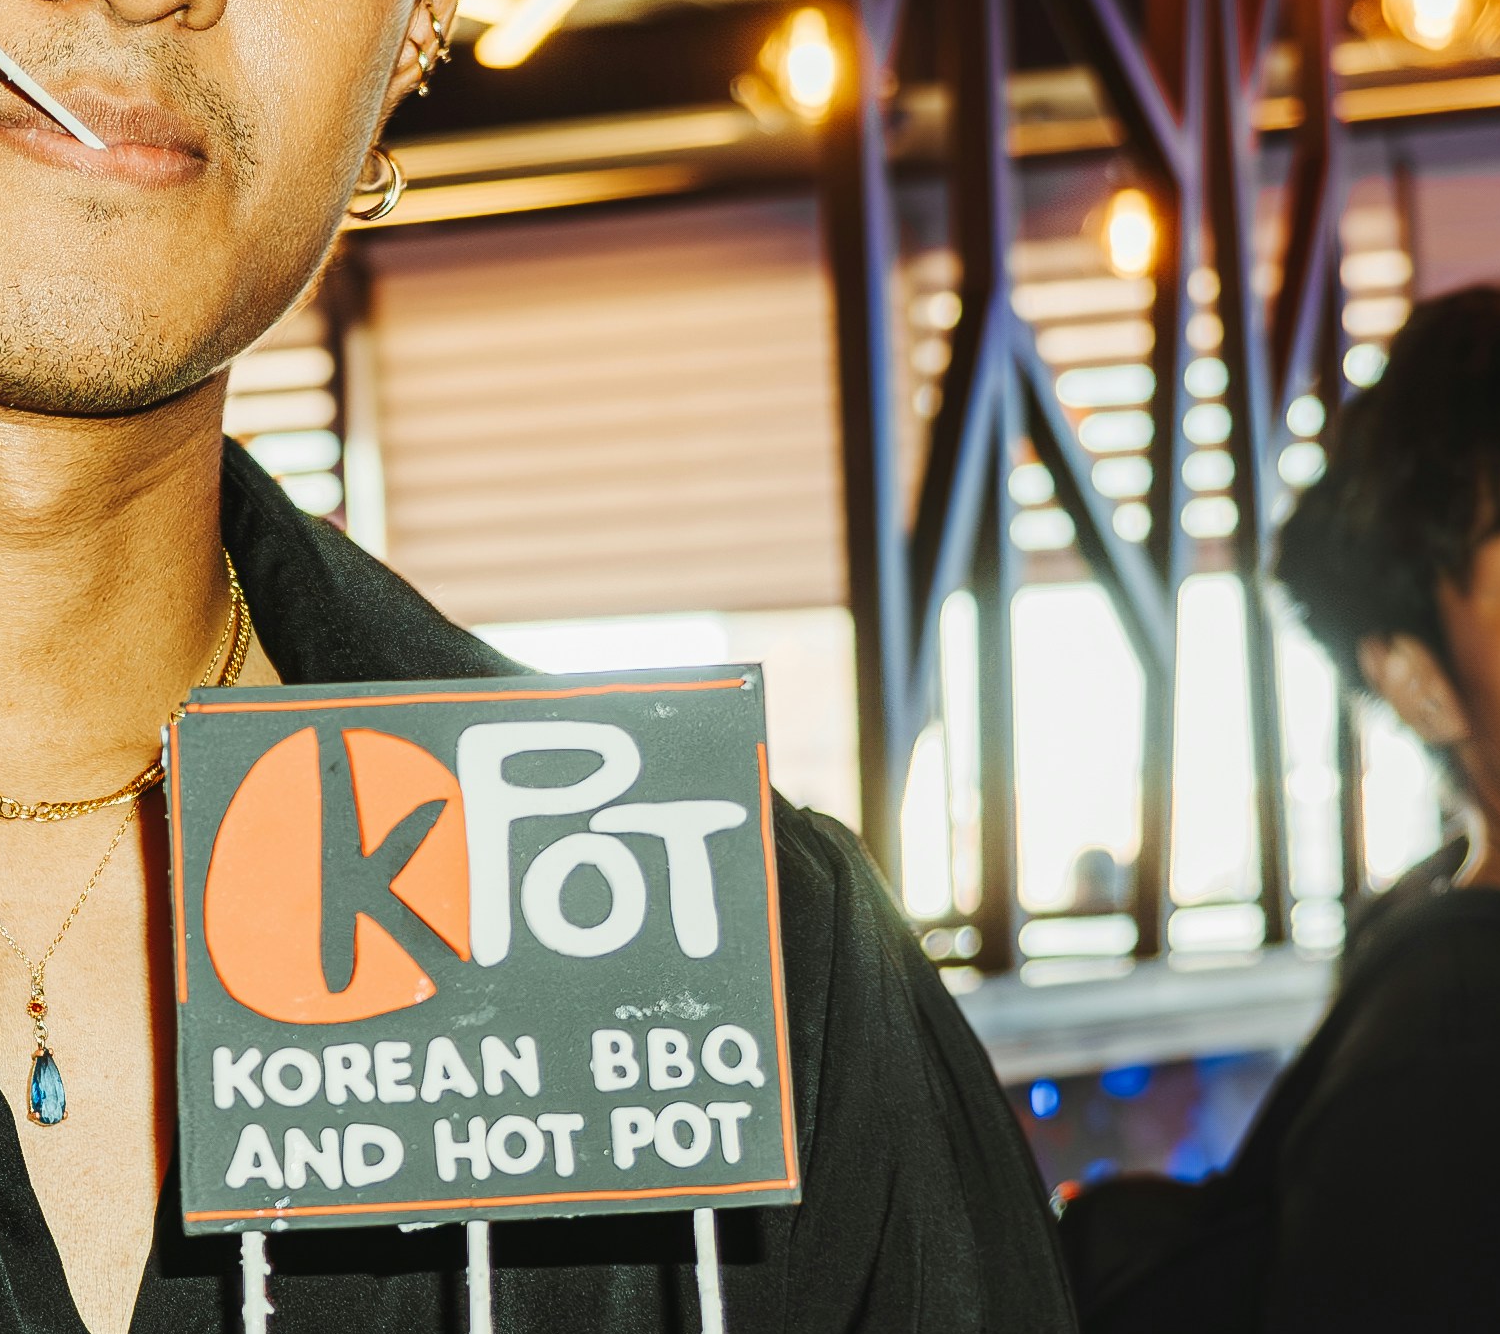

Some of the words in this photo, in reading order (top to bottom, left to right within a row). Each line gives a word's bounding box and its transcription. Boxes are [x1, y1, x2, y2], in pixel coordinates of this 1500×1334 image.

[212, 1035, 541, 1110] KOREAN
[589, 1024, 766, 1092] BBQ
[225, 1123, 405, 1190] AND
[433, 1113, 585, 1182] HOT
[610, 1101, 752, 1170] POT
